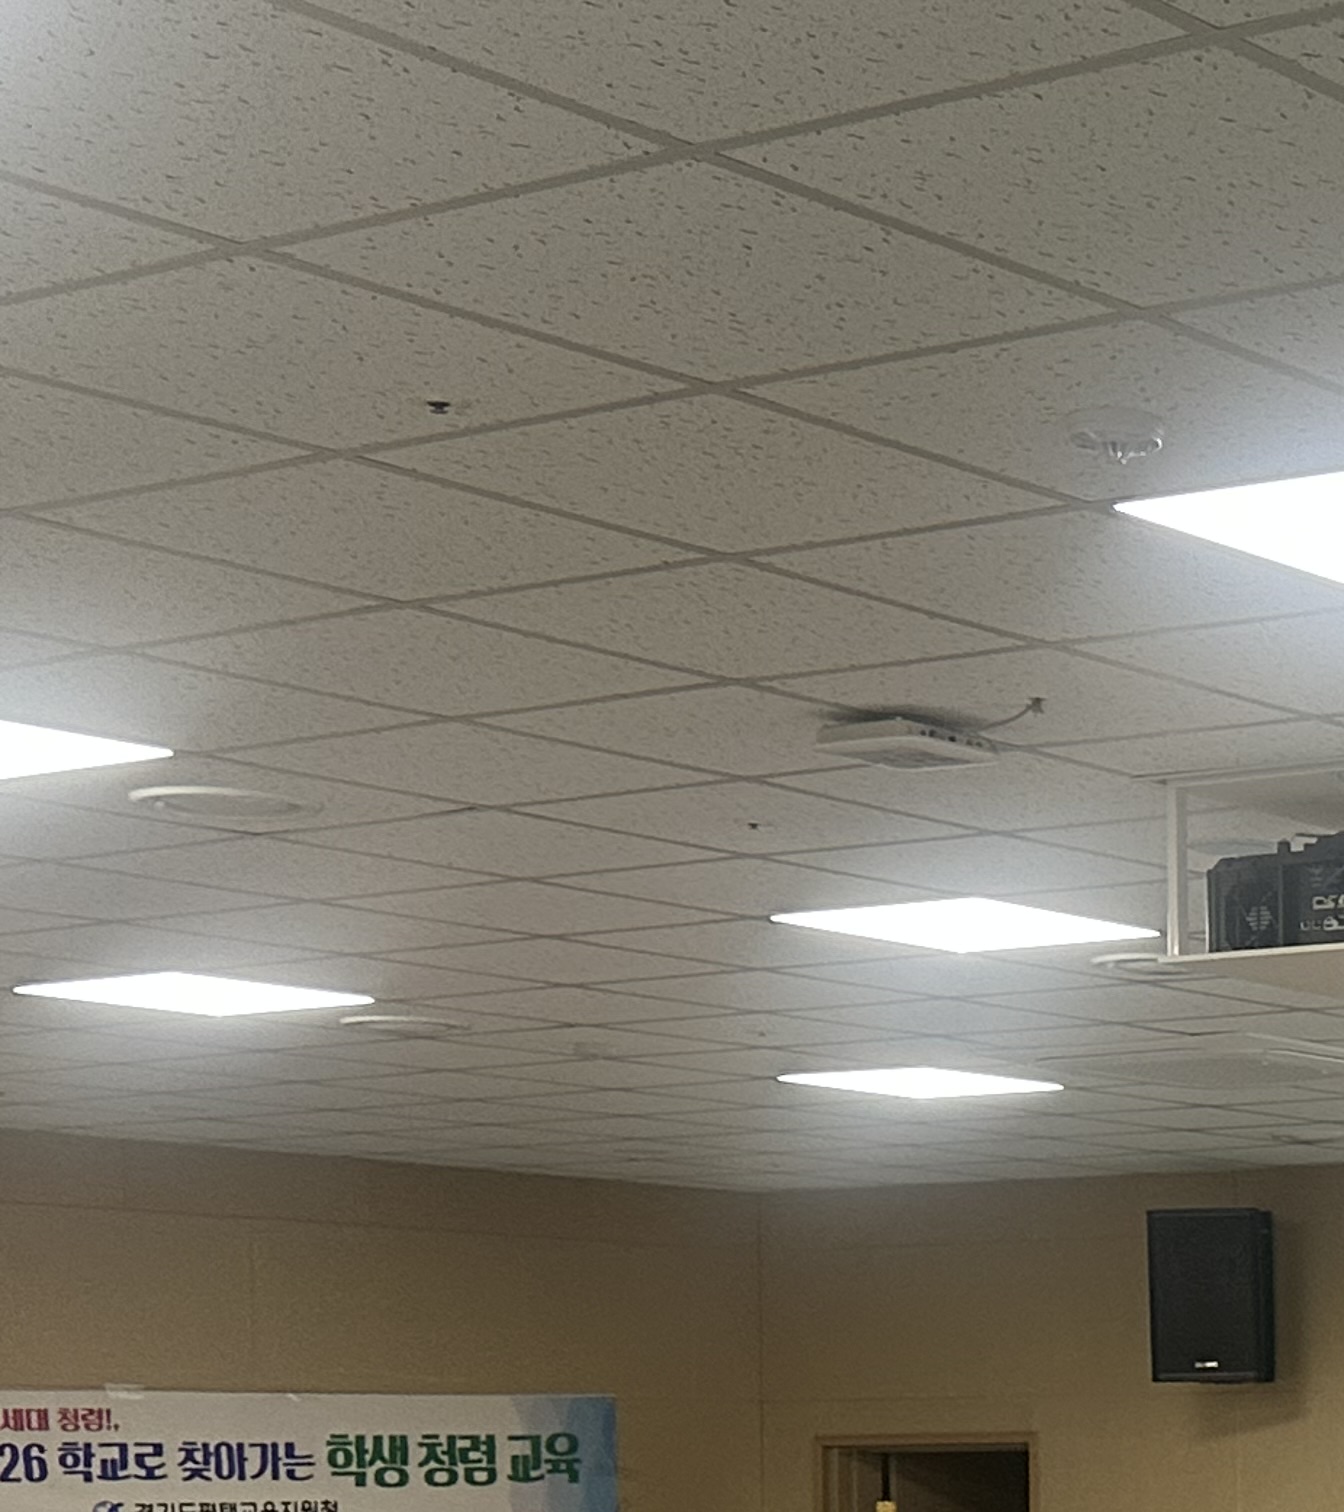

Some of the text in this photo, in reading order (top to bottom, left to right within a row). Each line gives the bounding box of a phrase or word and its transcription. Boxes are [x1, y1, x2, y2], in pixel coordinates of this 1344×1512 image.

[57, 1442, 168, 1483] 학교로
[177, 1441, 316, 1482] 찾아가는
[326, 1434, 410, 1487] 학생
[417, 1434, 498, 1487] 청렴
[507, 1432, 582, 1484] 교육
